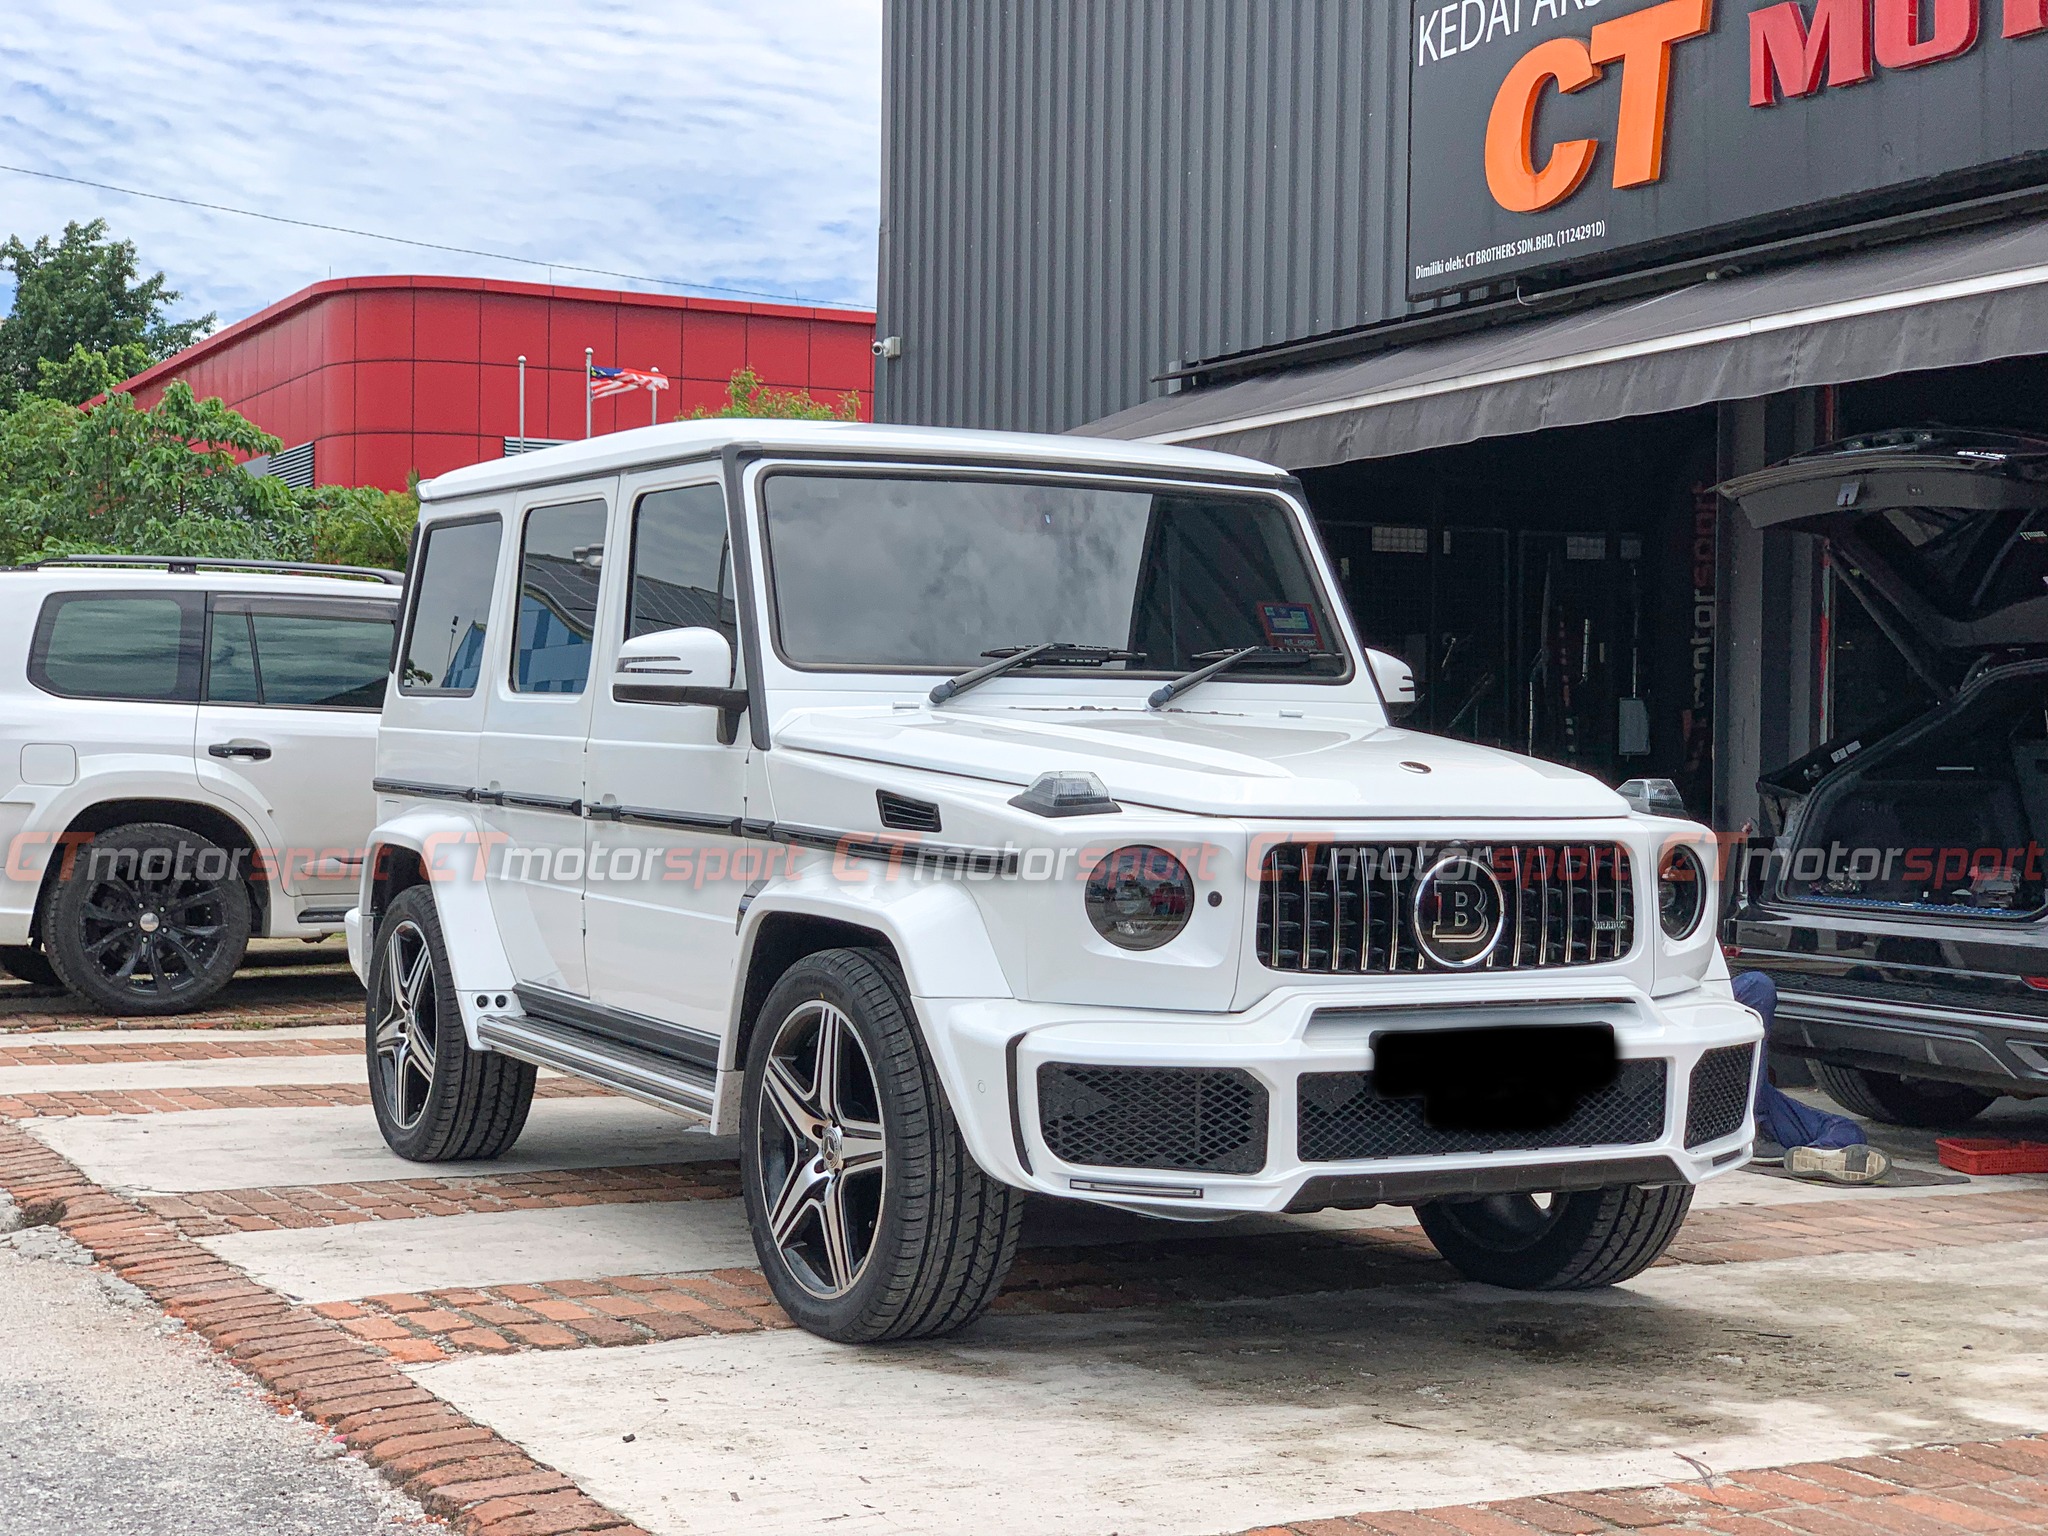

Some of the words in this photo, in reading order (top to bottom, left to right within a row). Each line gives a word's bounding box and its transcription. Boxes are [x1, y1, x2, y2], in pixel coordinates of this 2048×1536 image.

[1418, 0, 1519, 67] KEDAI
[1484, 0, 1711, 213] CT
[1415, 260, 1444, 279] Dimiliki
[1444, 255, 1465, 272] oleh:
[1465, 253, 1475, 268] CT
[1475, 242, 1516, 264] BROTHERS
[1516, 233, 1556, 255] SDN.BHD.
[1556, 220, 1606, 248] (1124291D)
[1432, 880, 1489, 943] B
